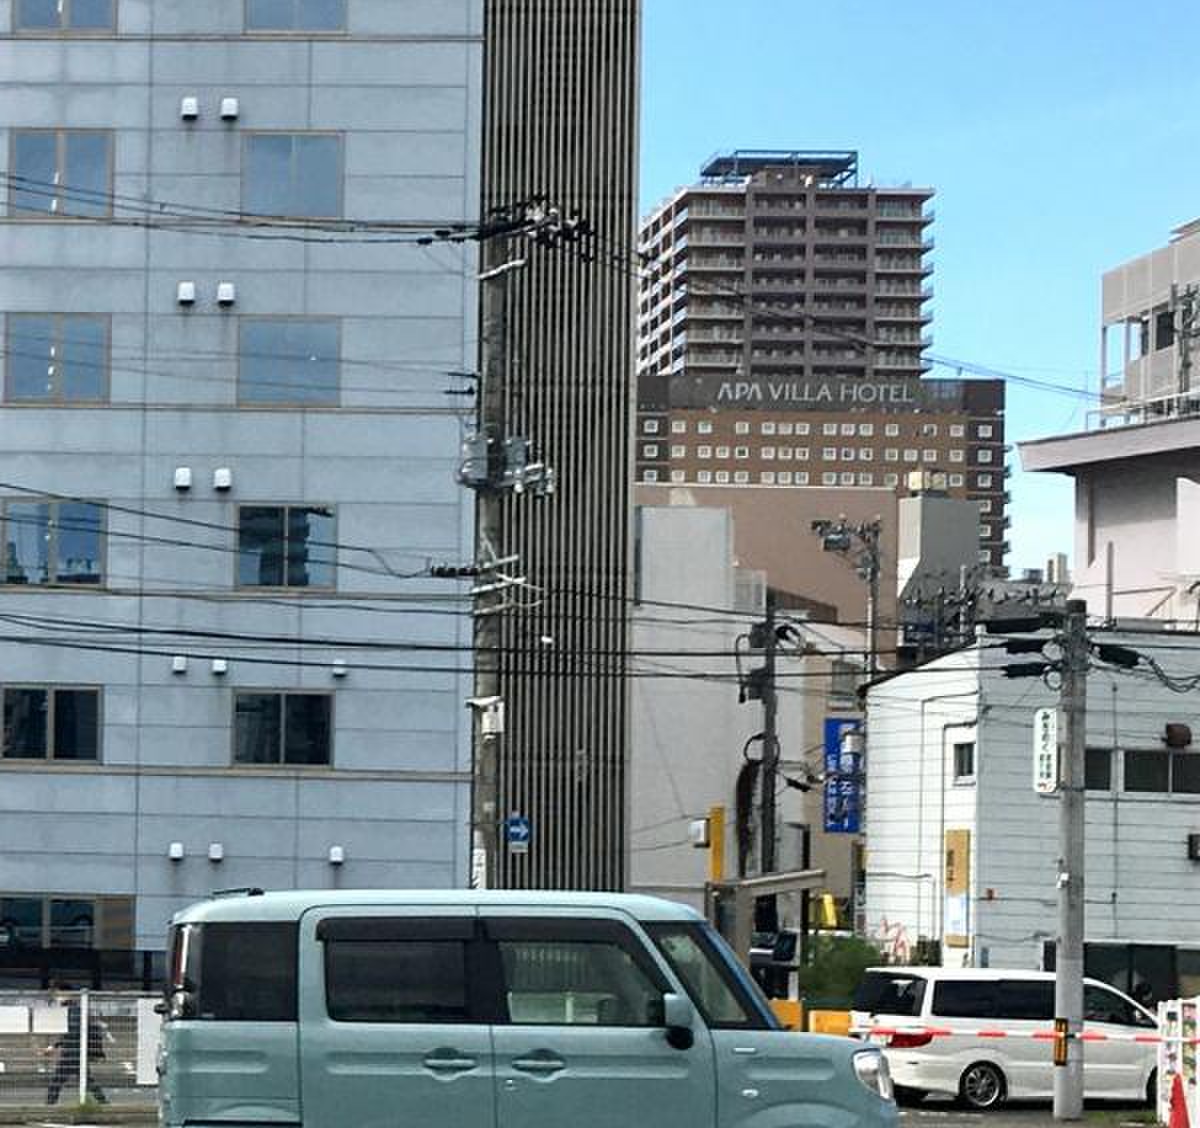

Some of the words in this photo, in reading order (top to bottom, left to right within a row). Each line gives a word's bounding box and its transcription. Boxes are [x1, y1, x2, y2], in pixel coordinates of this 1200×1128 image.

[717, 381, 763, 401] APA
[767, 382, 833, 402] VILLA
[839, 382, 915, 403] HOTEL
